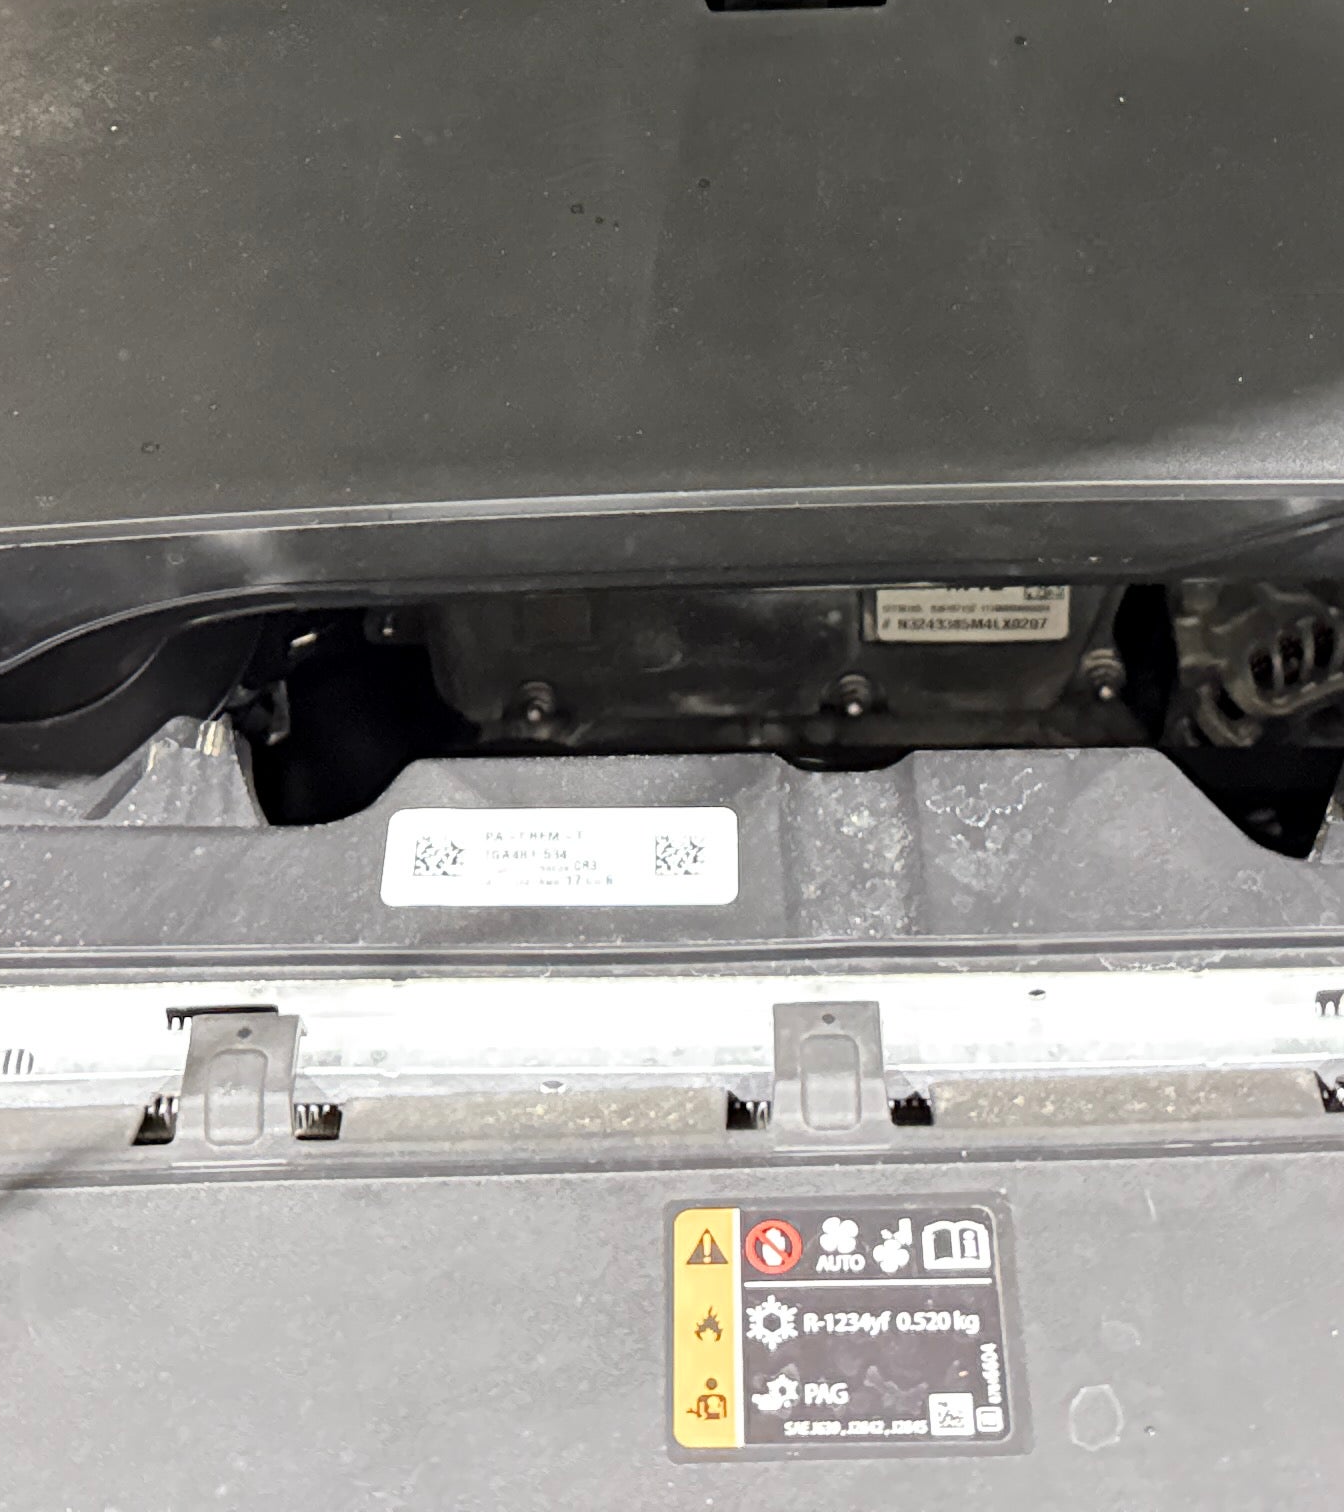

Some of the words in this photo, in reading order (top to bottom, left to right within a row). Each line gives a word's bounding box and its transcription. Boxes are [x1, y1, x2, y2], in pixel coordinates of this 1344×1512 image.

[816, 1254, 865, 1272] AUTO
[803, 1311, 892, 1336] R-1234yf
[895, 1311, 951, 1331] 0.520
[952, 1310, 980, 1335] kg
[804, 1382, 849, 1405] PAG
